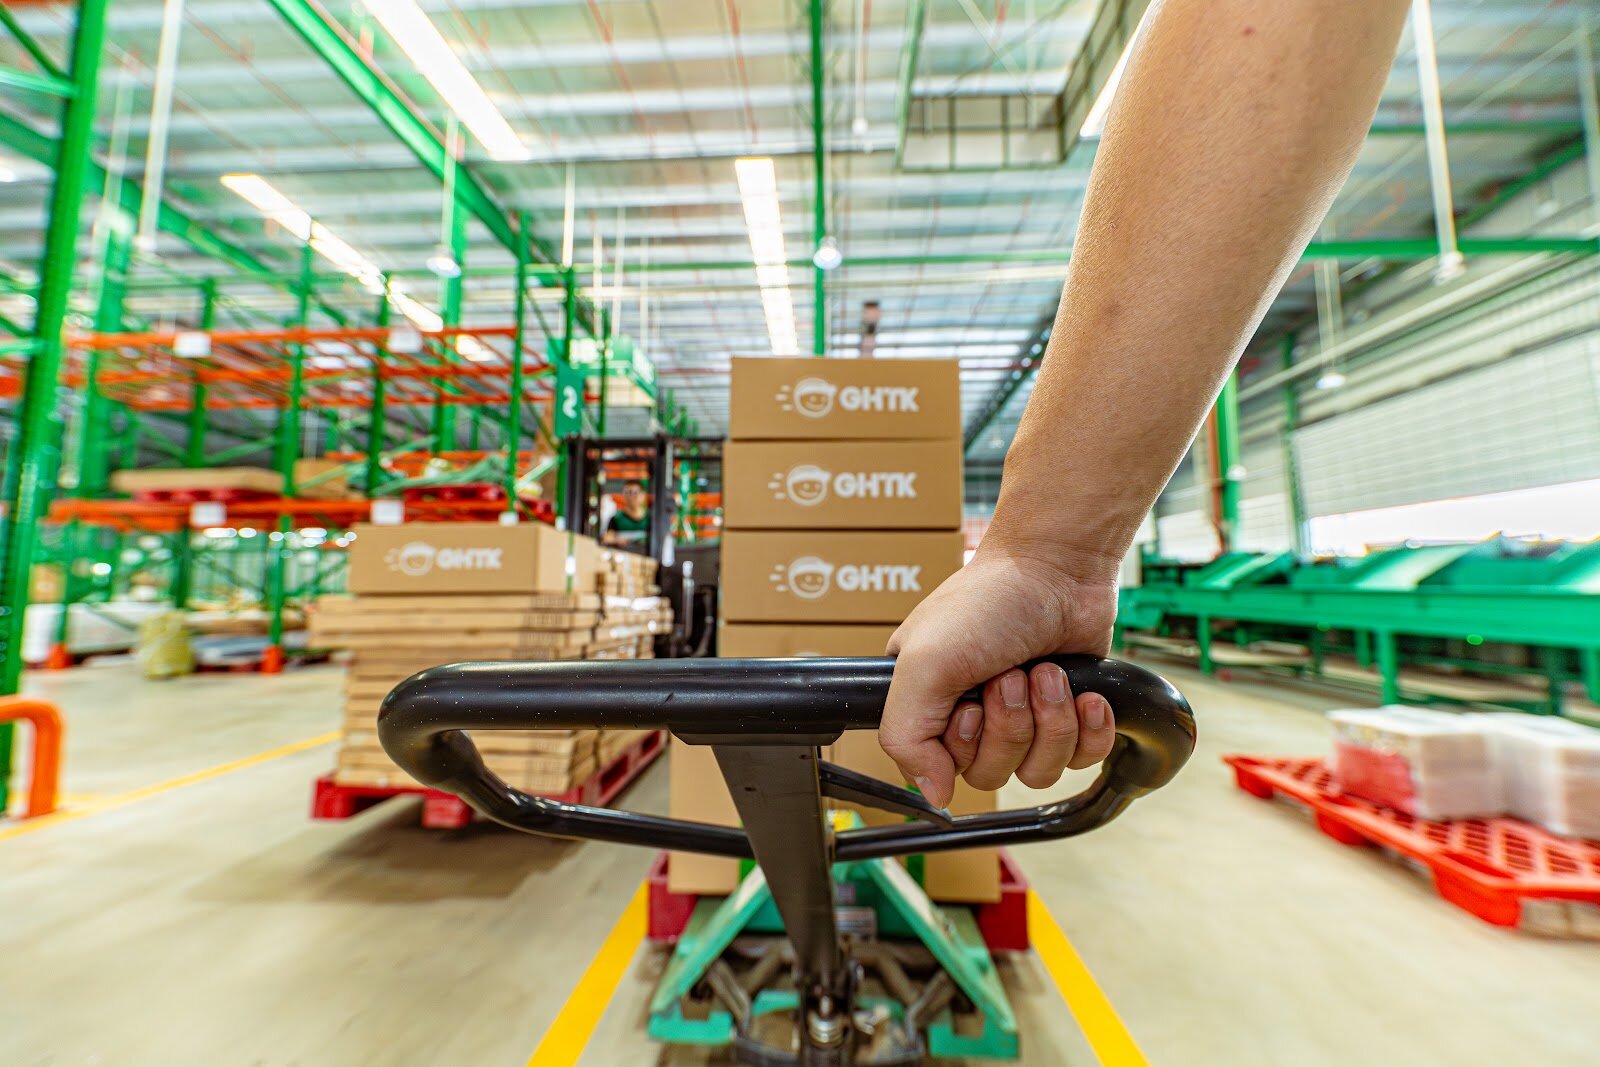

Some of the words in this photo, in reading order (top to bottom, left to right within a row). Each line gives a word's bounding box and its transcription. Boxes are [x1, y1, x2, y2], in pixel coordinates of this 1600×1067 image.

[838, 386, 919, 412] GHTK
[833, 472, 917, 498] GHTK
[436, 547, 502, 570] GHTK
[835, 564, 922, 591] GHTK
